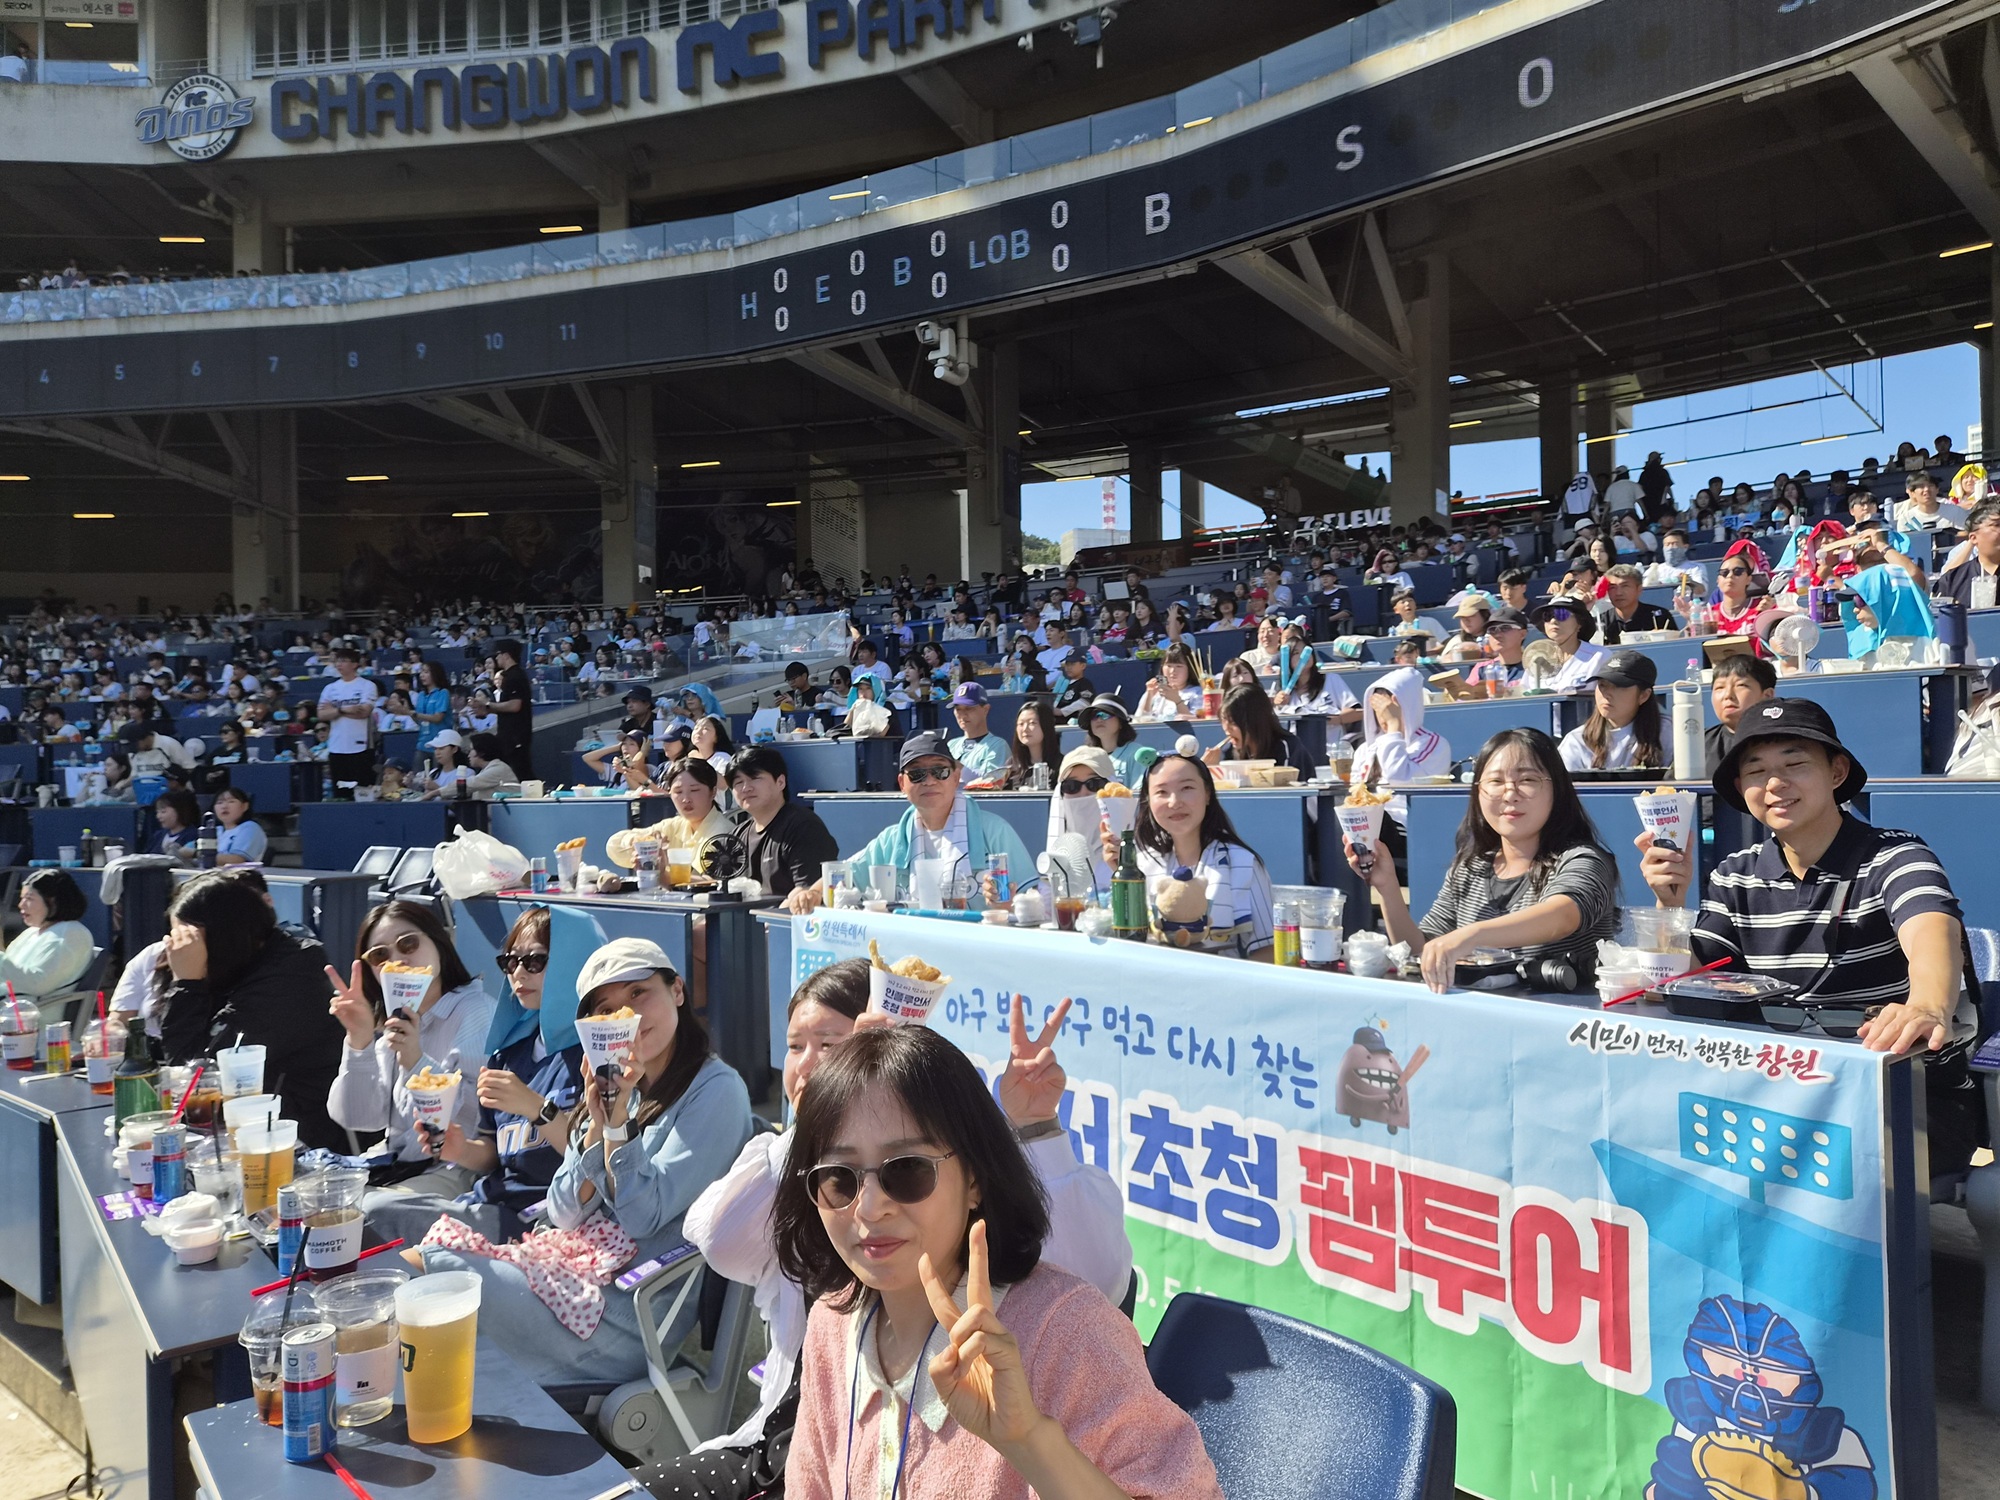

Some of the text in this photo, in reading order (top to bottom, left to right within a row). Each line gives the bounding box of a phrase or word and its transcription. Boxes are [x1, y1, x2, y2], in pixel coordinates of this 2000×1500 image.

[272, 35, 655, 142] CHANGWON
[677, 8, 784, 95] NC
[1145, 192, 1171, 235] B
[1335, 124, 1365, 171] S
[741, 228, 1030, 320] H E B LOB
[39, 323, 577, 385] 4 5 6 7 8 9 10 11
[822, 919, 868, 941] 창원특례시
[946, 988, 987, 1033] 야구
[1103, 1005, 1156, 1056] 먹고
[1168, 1026, 1235, 1076] 다시
[1251, 1034, 1318, 1109] 찾는
[1569, 1020, 1834, 1081] 시민이 먼저, 행복한 창원
[310, 1245, 342, 1254] COFFEE
[1127, 1104, 1281, 1250] 초청
[1297, 1145, 1632, 1374] 팸투어
